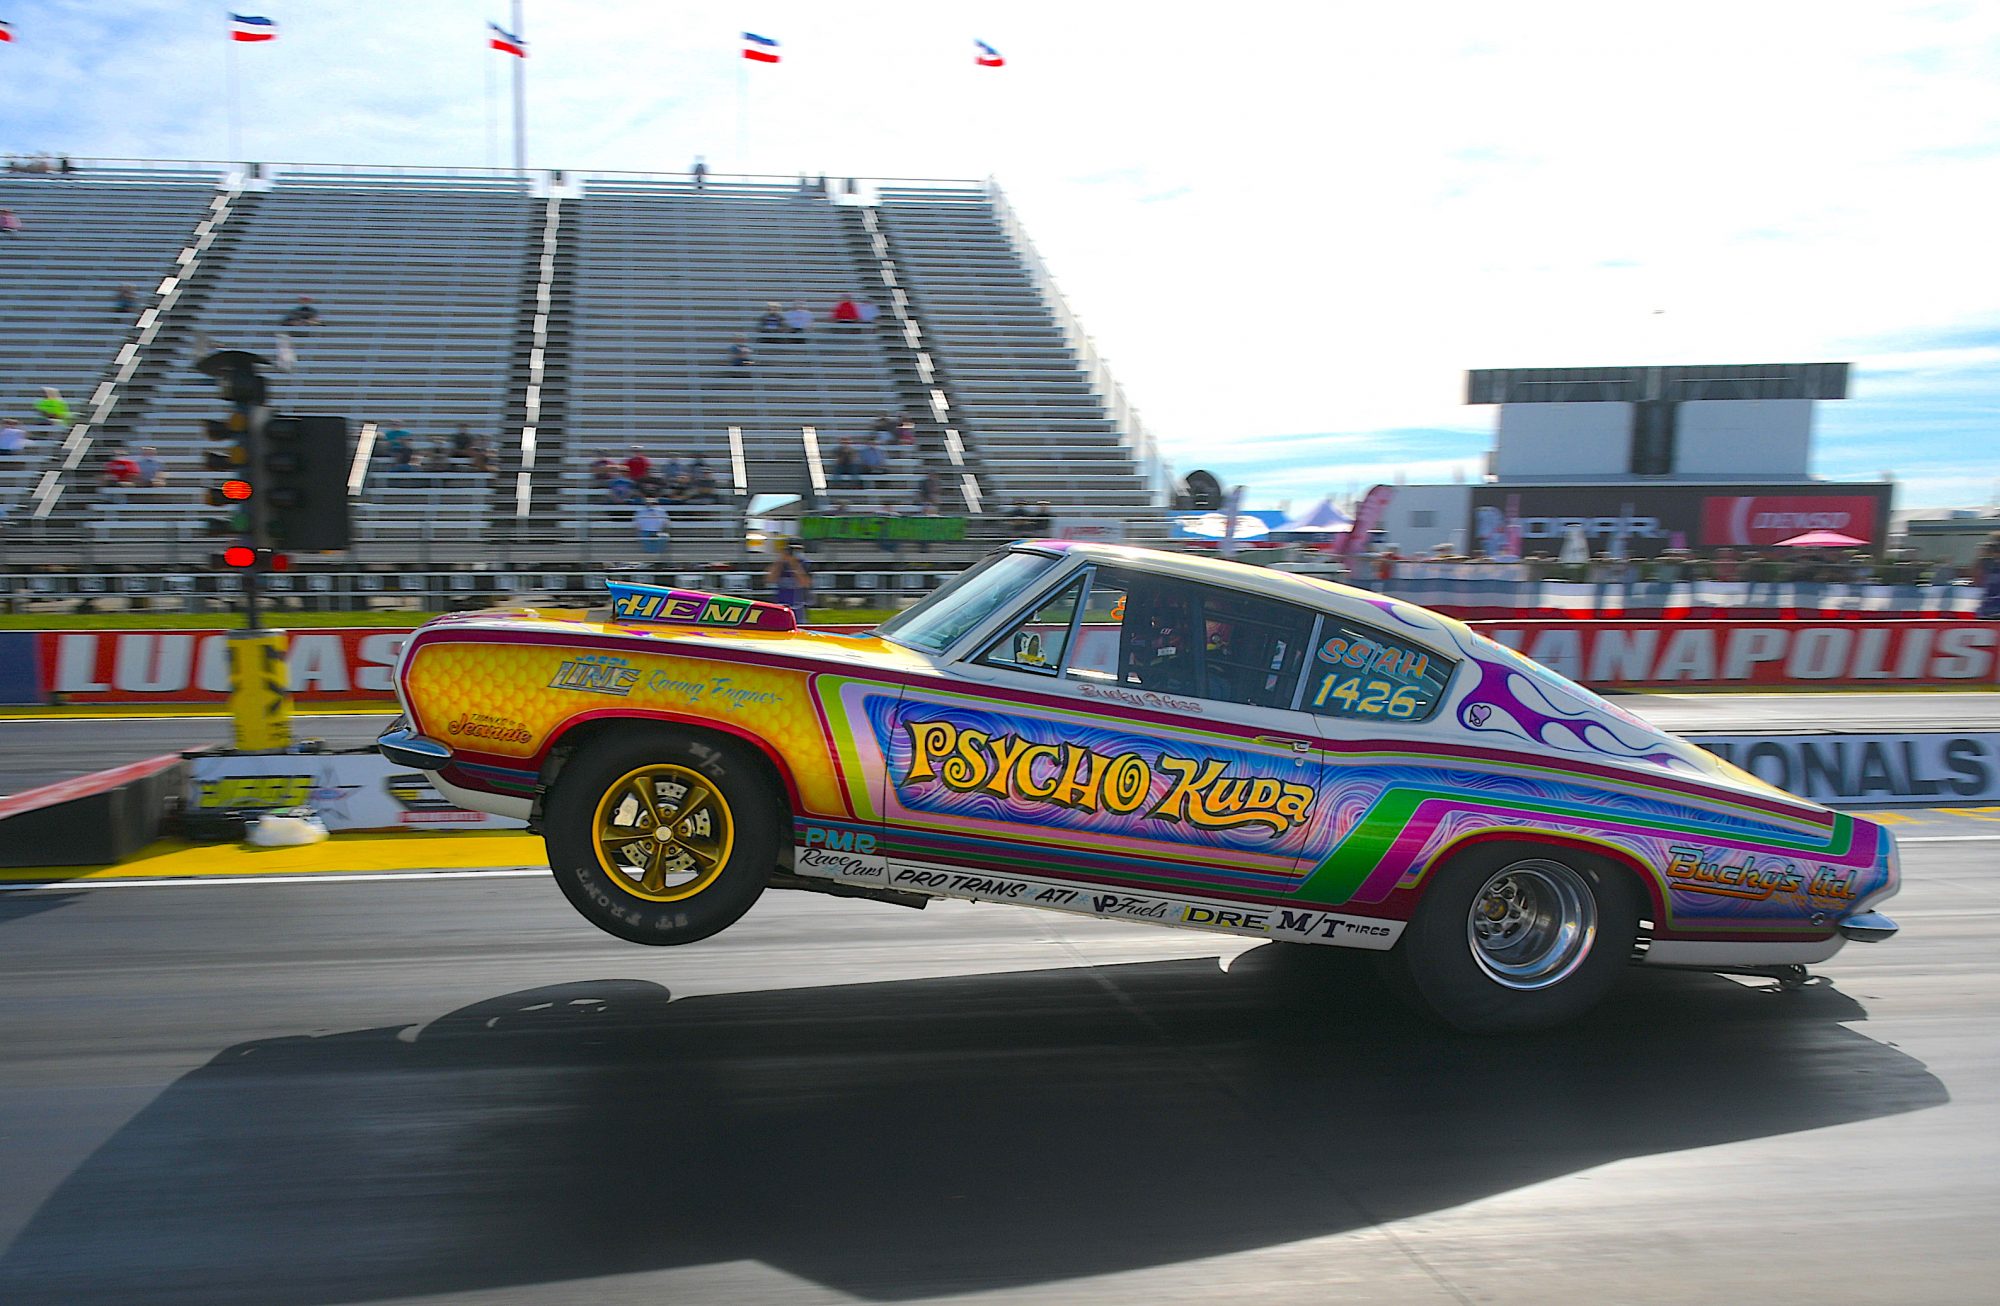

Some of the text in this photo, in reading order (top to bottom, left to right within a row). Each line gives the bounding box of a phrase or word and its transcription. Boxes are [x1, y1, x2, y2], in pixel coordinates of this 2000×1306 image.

[617, 594, 764, 624] HEMI
[1317, 637, 1430, 676] SS/AH
[547, 661, 641, 697] LINE
[1312, 672, 1422, 719] 1426
[448, 712, 532, 745] Jeannie
[902, 720, 1152, 816] PSYCHO
[804, 826, 877, 855] PMR
[799, 847, 885, 878] Race Cars
[1666, 846, 1805, 901] Bucky's
[894, 868, 950, 887] PRO
[949, 875, 1027, 898] TRANS
[1034, 889, 1080, 905] ATI
[1110, 899, 1170, 919] Fuels
[1186, 906, 1270, 931] DRE
[1276, 910, 1346, 939] M/T
[1345, 923, 1392, 937] TIRES
